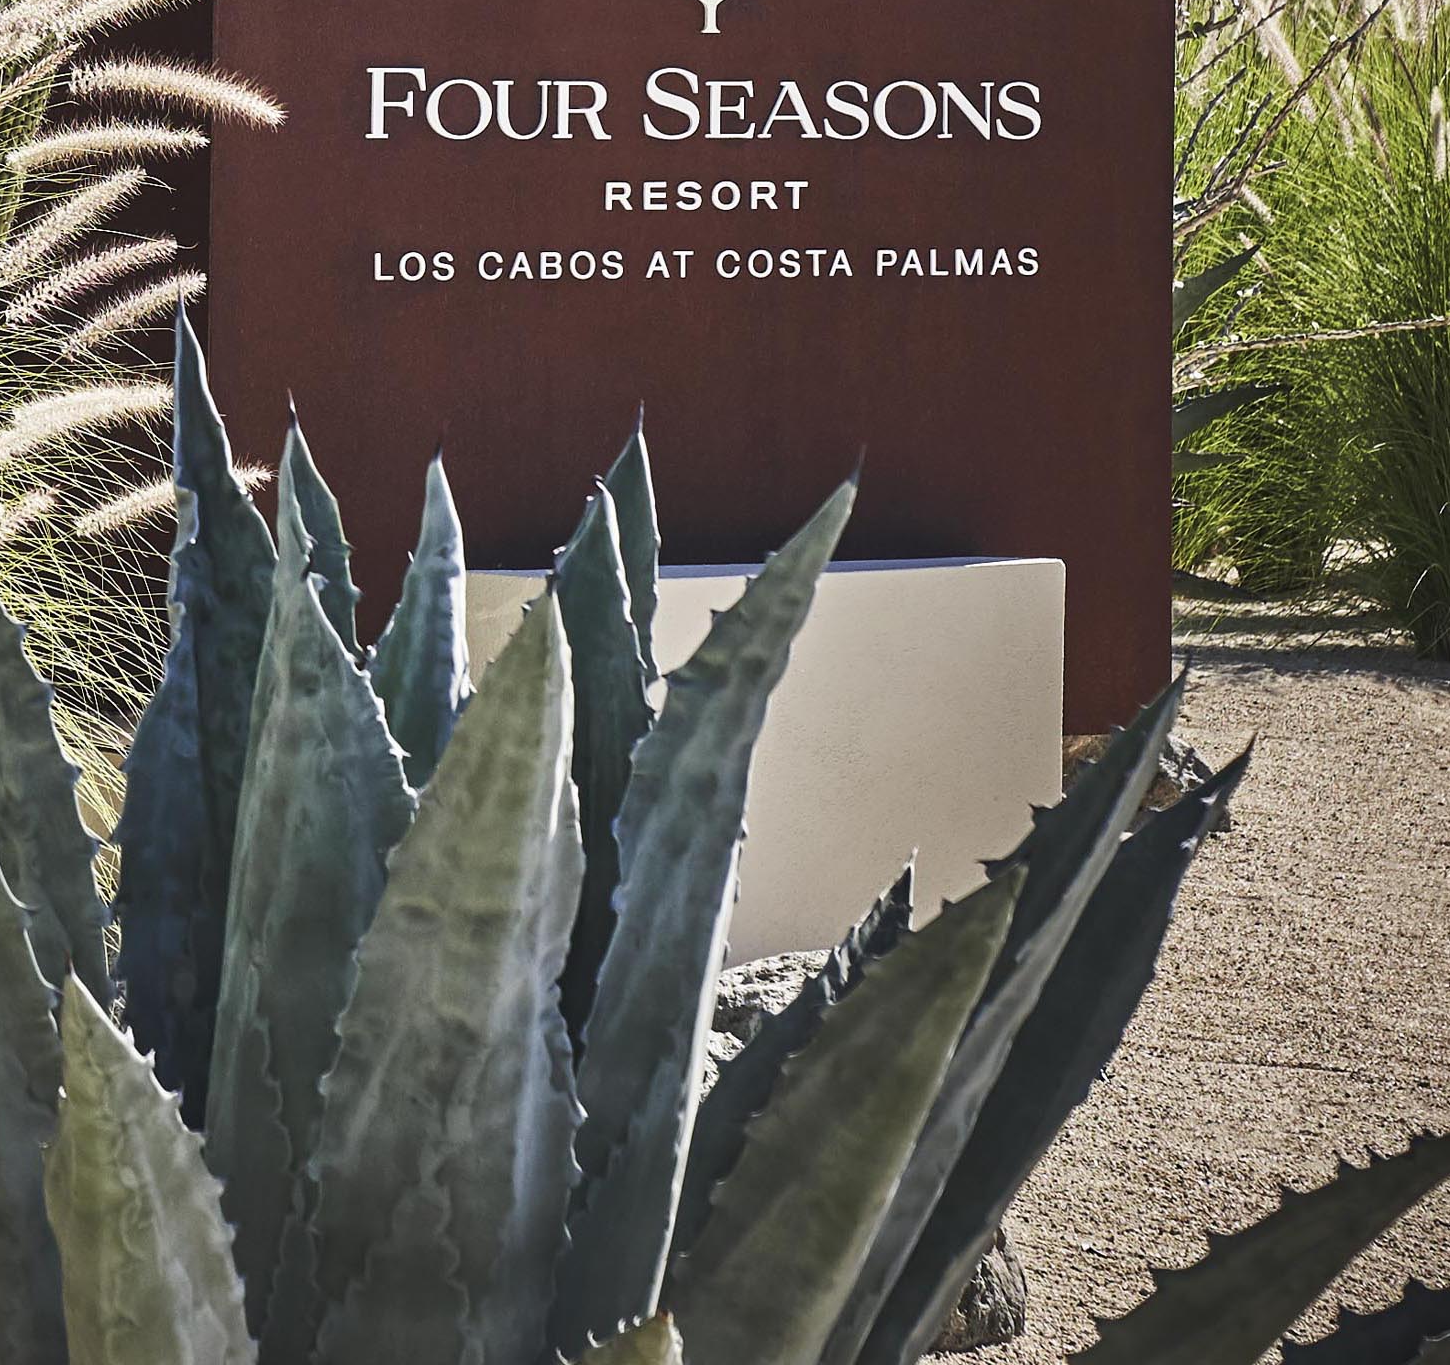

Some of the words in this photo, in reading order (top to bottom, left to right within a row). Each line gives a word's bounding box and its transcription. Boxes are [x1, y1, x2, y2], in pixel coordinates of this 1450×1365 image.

[364, 67, 612, 141] FOUR
[642, 67, 1042, 141] SEASONS
[604, 180, 809, 211] RESORT
[374, 251, 455, 282] LOS
[478, 250, 624, 281] CABOS
[645, 250, 695, 279] AT
[716, 248, 853, 279] COSTA
[876, 247, 1039, 277] PALMAS
